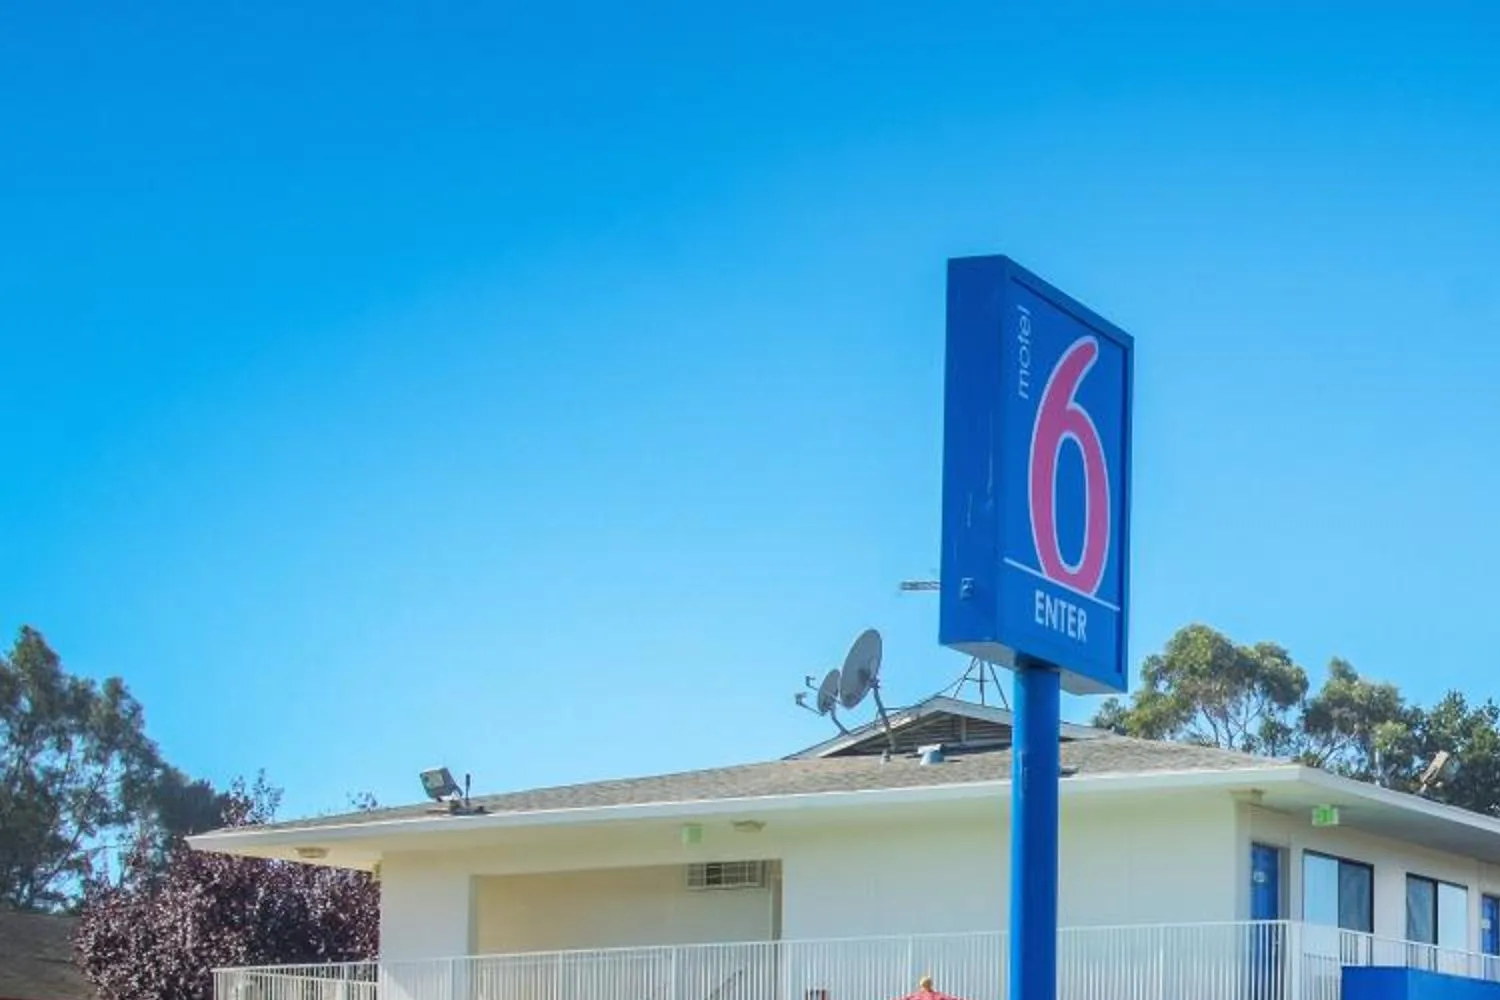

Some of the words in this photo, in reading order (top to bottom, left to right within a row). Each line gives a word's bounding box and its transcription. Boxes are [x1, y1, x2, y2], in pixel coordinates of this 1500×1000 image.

[1017, 304, 1031, 400] motel
[1028, 334, 1110, 600] 6
[1034, 588, 1088, 643] ENTER
